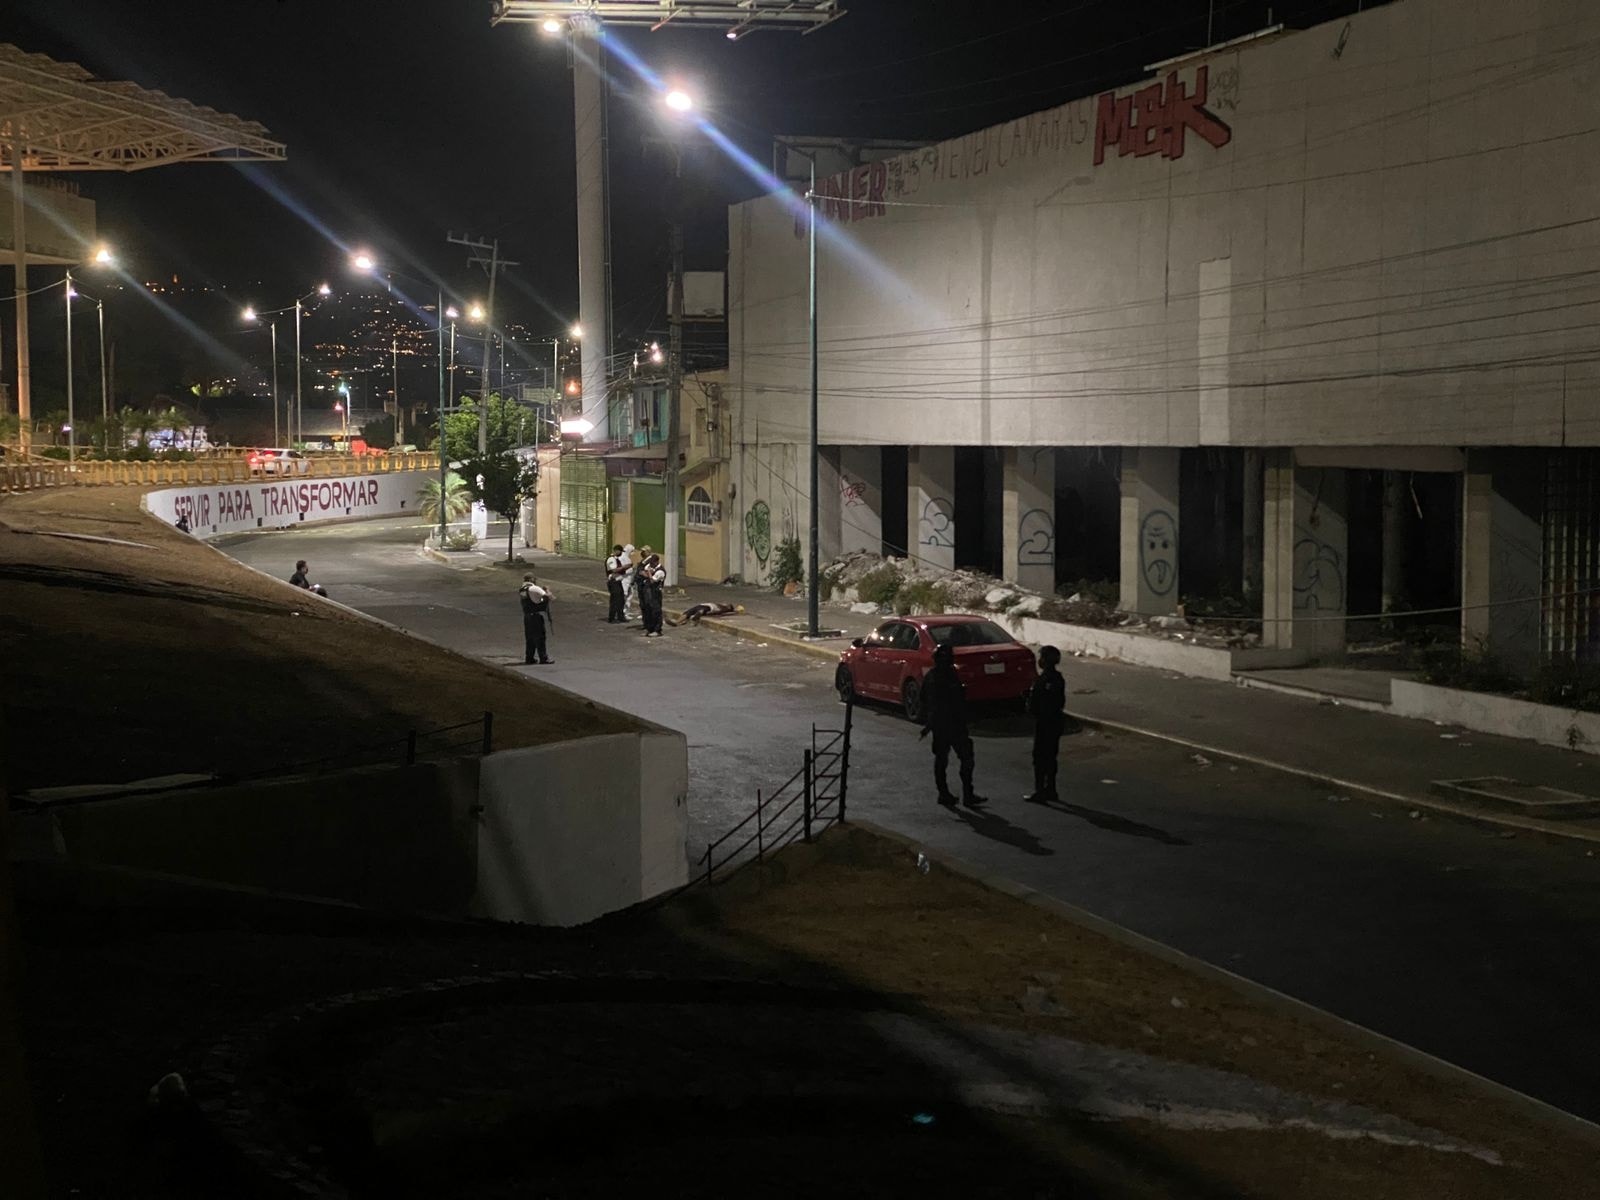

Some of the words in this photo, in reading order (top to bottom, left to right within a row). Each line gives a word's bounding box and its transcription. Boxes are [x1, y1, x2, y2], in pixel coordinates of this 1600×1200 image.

[174, 493, 210, 529] SERVIR
[218, 489, 254, 523] PARA
[260, 478, 379, 517] TRANSFORMAR
